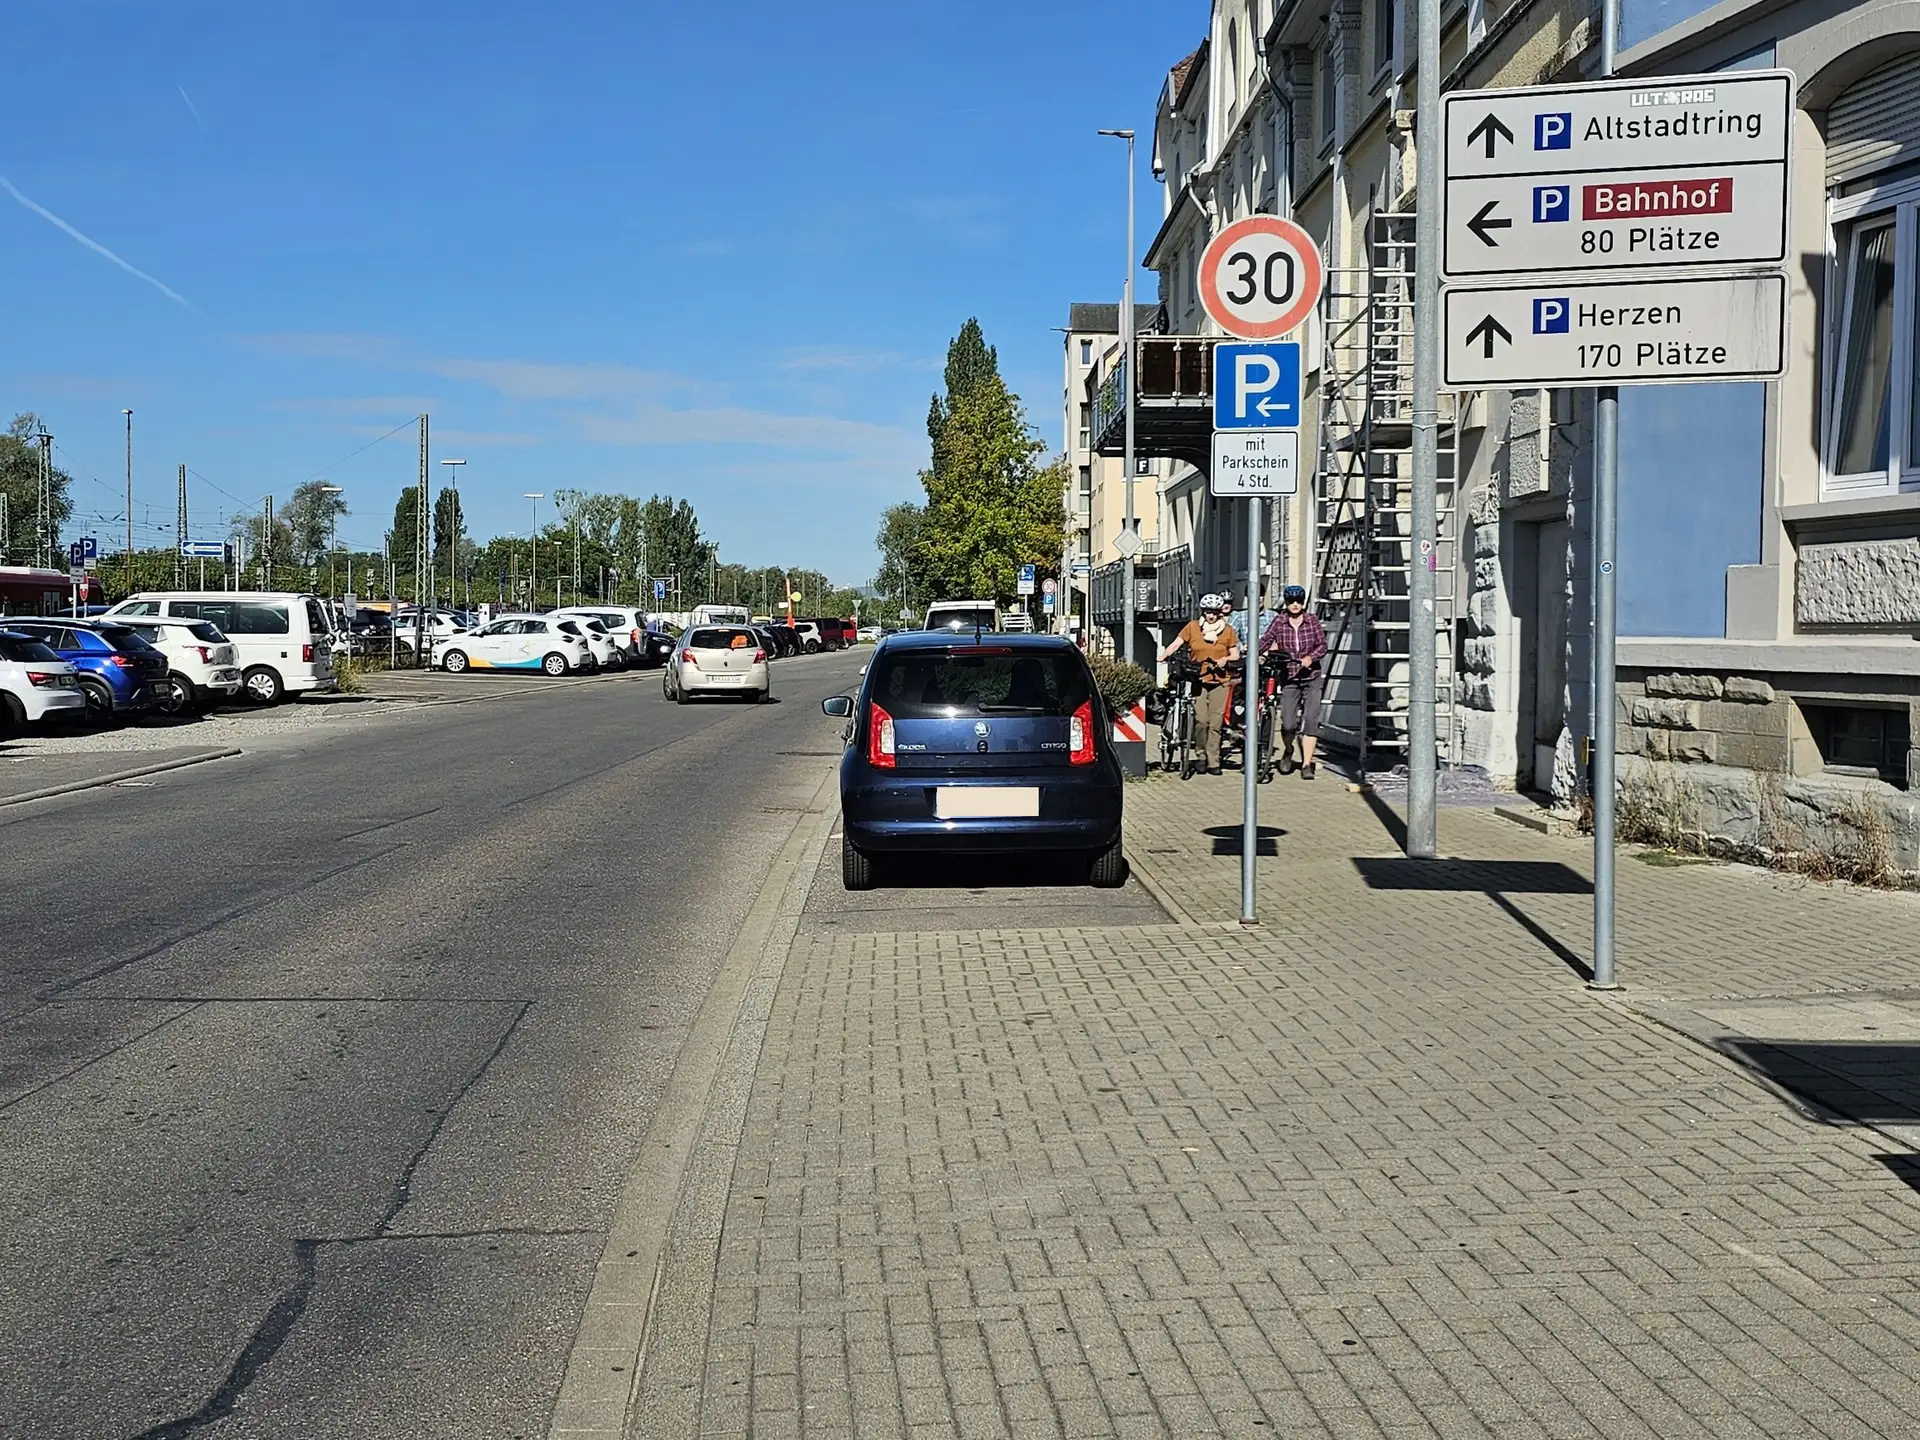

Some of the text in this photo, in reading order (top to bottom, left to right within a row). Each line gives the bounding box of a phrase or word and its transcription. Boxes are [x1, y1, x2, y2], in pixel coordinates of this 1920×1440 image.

[1543, 111, 1762, 147] P Altstadtring
[1540, 183, 1720, 220] P Bahnhof
[1581, 227, 1720, 254] 80 Plätze
[1226, 251, 1295, 305] 30
[1540, 300, 1681, 331] P Herzen
[1578, 341, 1727, 369] 170 Plätze
[1235, 354, 1281, 418] P
[1245, 436, 1266, 451] mit
[1138, 460, 1147, 472] F
[1222, 454, 1289, 469] Parkschein
[1237, 474, 1273, 488] 4 Std.
[83, 540, 93, 556] P
